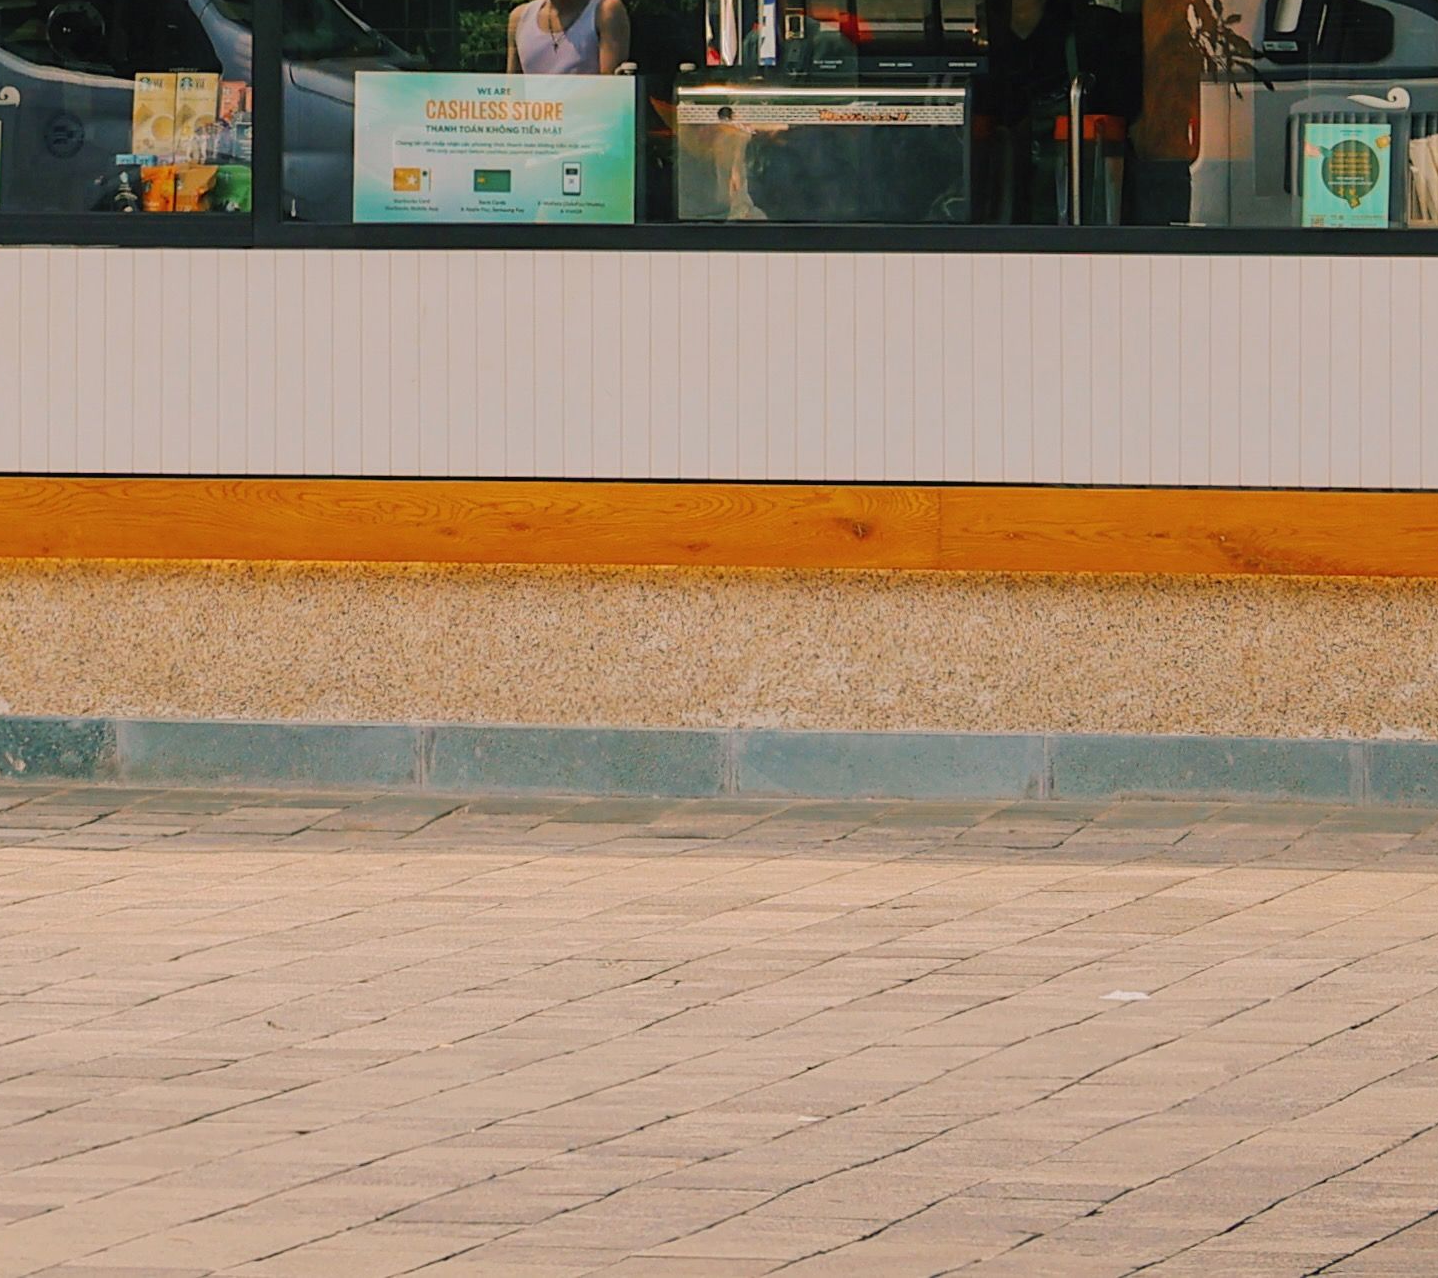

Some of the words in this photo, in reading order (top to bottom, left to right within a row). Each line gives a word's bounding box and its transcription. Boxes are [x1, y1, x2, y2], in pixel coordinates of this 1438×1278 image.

[477, 87, 491, 96] WE
[494, 87, 511, 96] ARE
[425, 99, 509, 121] CASHLESS
[512, 100, 563, 122] STORE
[425, 125, 458, 133] THANH
[486, 123, 520, 134] KHÔNG
